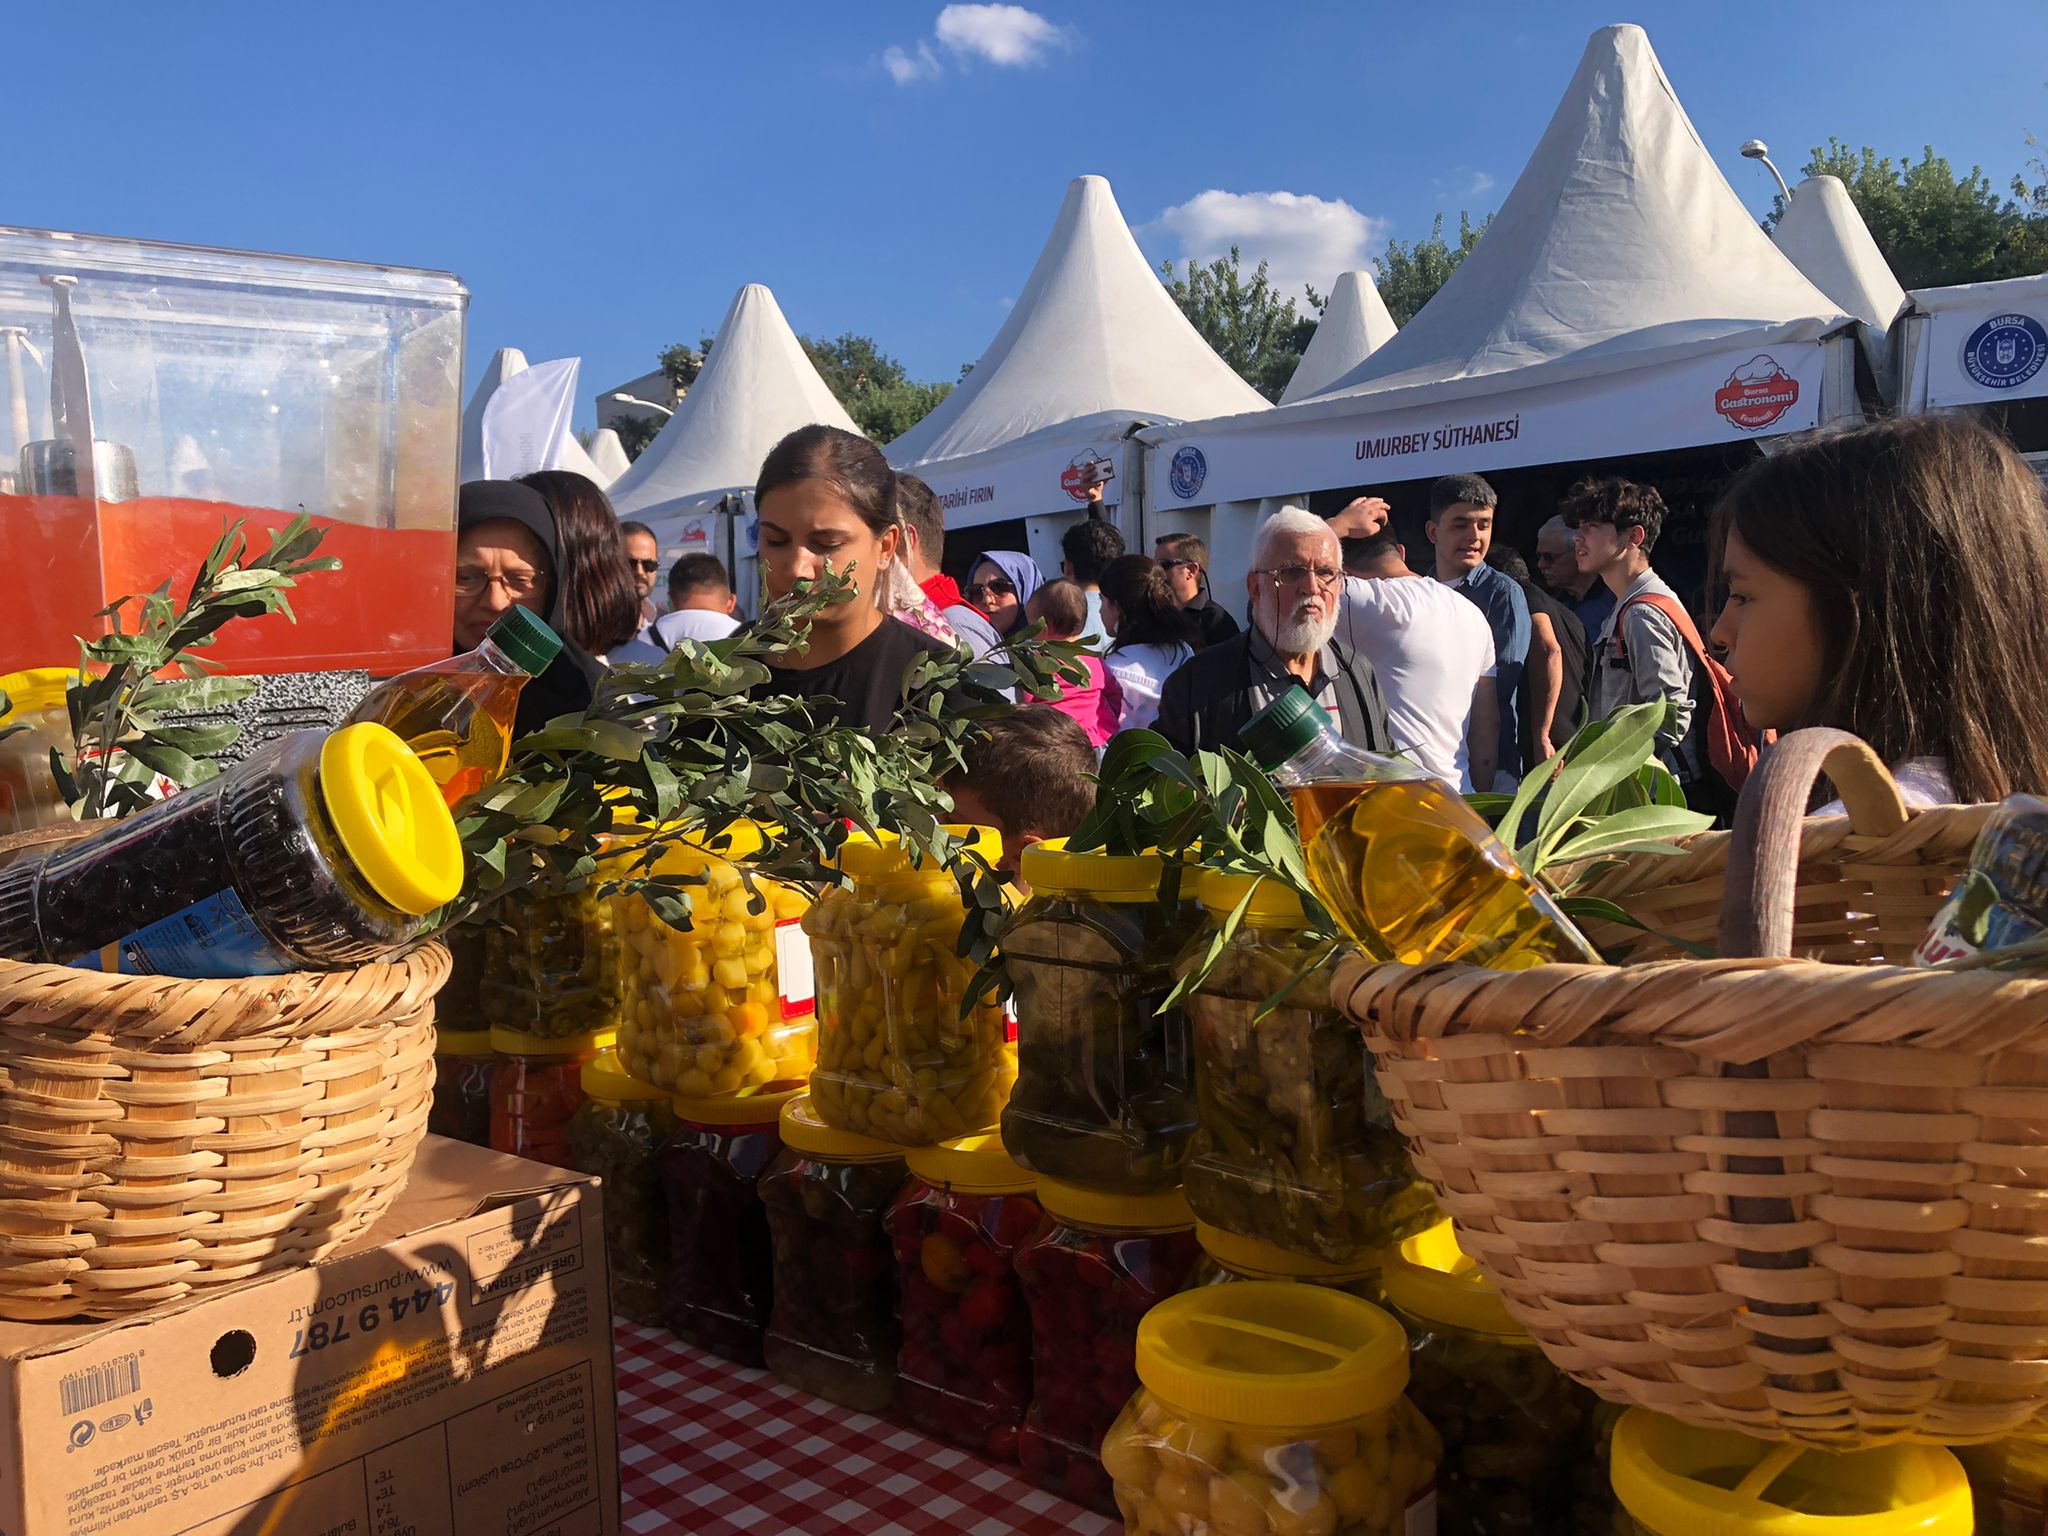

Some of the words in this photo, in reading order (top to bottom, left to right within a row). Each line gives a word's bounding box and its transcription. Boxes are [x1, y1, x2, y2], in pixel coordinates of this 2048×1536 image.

[1989, 316, 2025, 329] BURSA
[1720, 390, 1794, 409] Gastronomi
[1744, 387, 1768, 396] Bursa
[1740, 410, 1773, 424] Festivali
[1355, 431, 1430, 460] UMURBEY
[1433, 413, 1519, 450] SÜTHANESİ
[938, 486, 968, 509] TARİHİ
[969, 485, 994, 504] FIRIN
[524, 1252, 575, 1282] ÜRETİCİ
[286, 1253, 452, 1325] www.pursu.com.tr
[478, 1271, 521, 1298] FİRMA
[387, 1276, 454, 1324] 444
[525, 1298, 548, 1312] uygun
[357, 1302, 380, 1334] 9
[510, 1318, 525, 1329] son
[527, 1314, 535, 1322] ve
[532, 1323, 542, 1332] bir
[288, 1312, 350, 1359] 787
[496, 1328, 529, 1345] ortamda
[101, 1351, 134, 1370] 682815
[503, 1347, 507, 1355] 2
[62, 1364, 96, 1382] 041199
[392, 1365, 402, 1374] ve
[248, 1405, 266, 1419] tabi
[271, 1406, 328, 1434] ambalajında
[183, 1413, 245, 1441] tutulmuştur.
[224, 1415, 271, 1438] altındadır.
[248, 1429, 266, 1442] son
[287, 1417, 329, 1441] otomatik
[146, 1437, 181, 1458] Tescilli
[207, 1434, 220, 1446] Bir
[284, 1442, 297, 1452] Su
[299, 1427, 334, 1449] Kaynak
[168, 1439, 203, 1463] günlük
[199, 1438, 244, 1462] kullanma
[223, 1435, 284, 1464] makinelerde
[93, 1451, 143, 1475] markadır.
[129, 1456, 163, 1475] üretim
[155, 1457, 194, 1479] tarihine
[223, 1462, 245, 1476] San.
[110, 1471, 125, 1483] bir
[120, 1474, 150, 1492] kadar
[165, 1460, 220, 1487] üretilmiştir.
[210, 1472, 221, 1482] ve
[65, 1475, 106, 1499] partidir.
[131, 1483, 161, 1499] Serin,
[169, 1485, 188, 1500] A.Ş.
[189, 1477, 207, 1490] Tic.
[68, 1488, 116, 1515] tazeliğini
[95, 1496, 128, 1514] temiz,
[113, 1493, 167, 1521] tarafından
[376, 1500, 392, 1518] 7,4
[69, 1510, 94, 1525] kuru
[377, 1512, 399, 1534] 76,4
